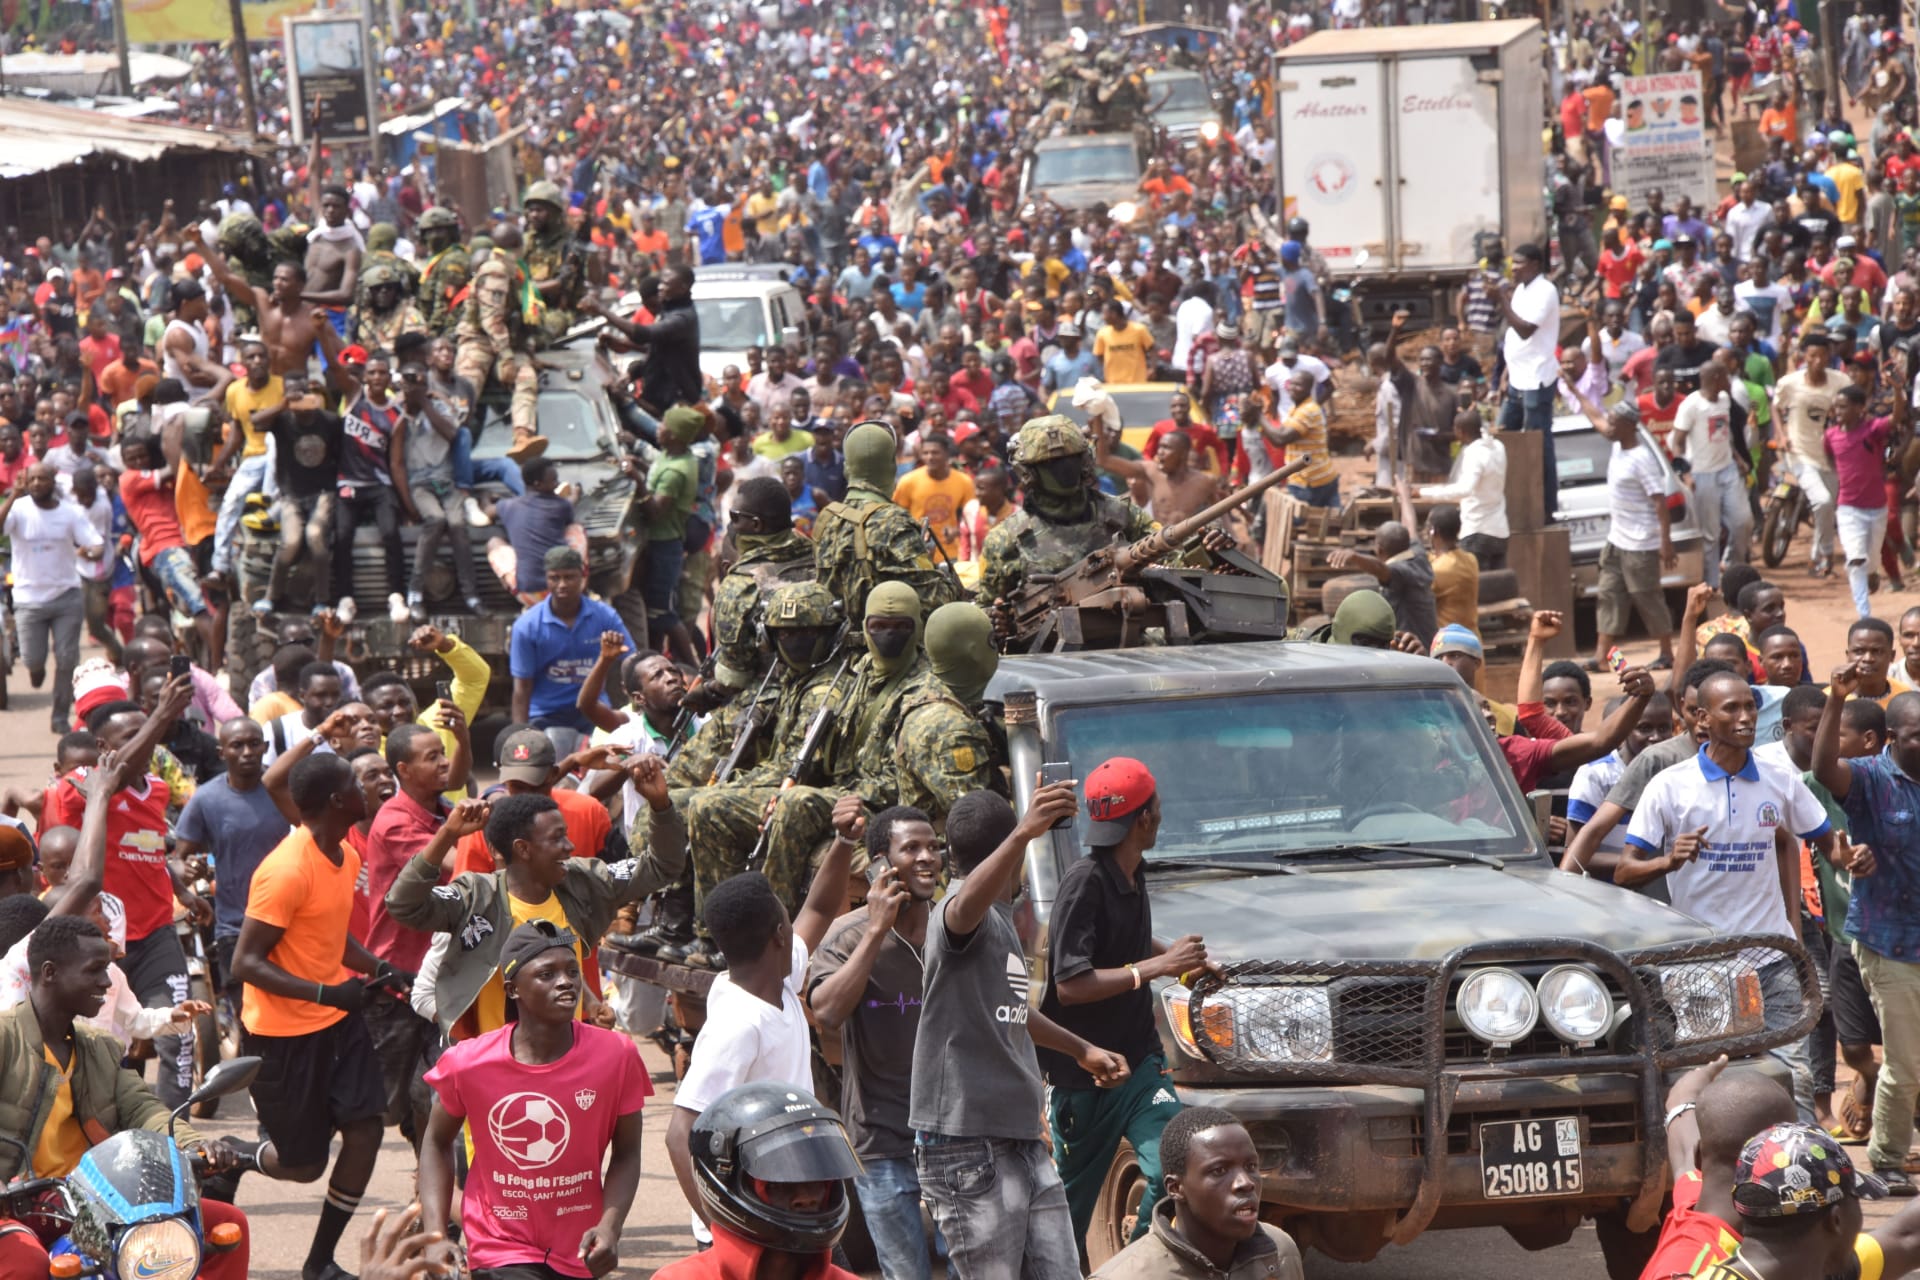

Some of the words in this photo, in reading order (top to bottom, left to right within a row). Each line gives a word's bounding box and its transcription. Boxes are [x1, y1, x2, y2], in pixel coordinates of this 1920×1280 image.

[1294, 102, 1368, 118] Abattoir
[1728, 864, 1755, 872] VILLAGE
[996, 1003, 1028, 1025] adid
[1513, 1122, 1542, 1153] AG
[536, 1175, 551, 1188] de
[533, 1192, 554, 1202] SANT
